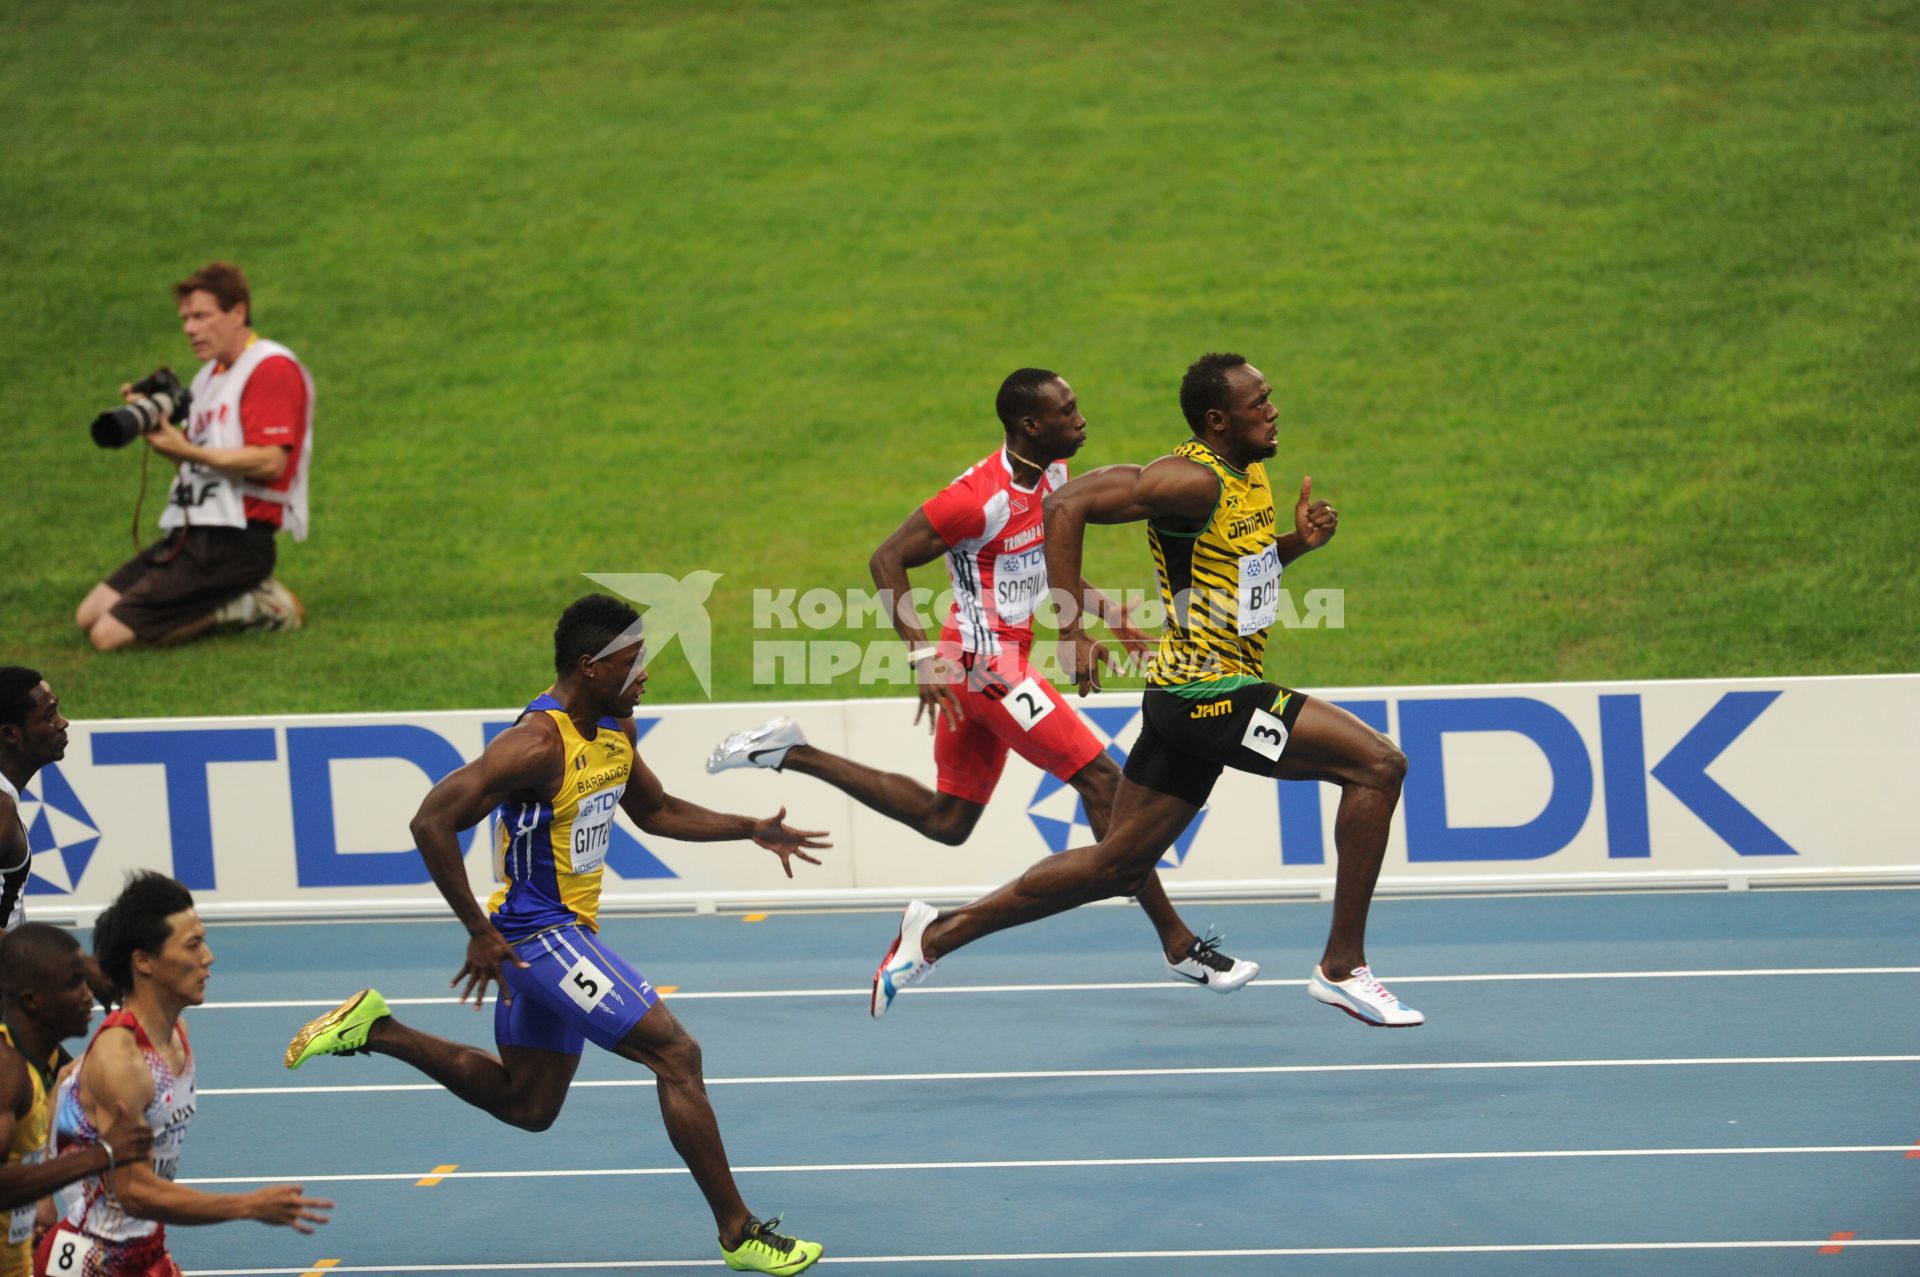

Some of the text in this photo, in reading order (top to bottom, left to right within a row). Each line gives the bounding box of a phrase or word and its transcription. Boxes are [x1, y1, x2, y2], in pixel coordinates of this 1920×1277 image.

[1228, 505, 1275, 540] JAMAIC
[1004, 527, 1035, 552] TRINIDAD
[1020, 546, 1045, 569] TD
[1015, 692, 1043, 720] 2
[1190, 700, 1232, 719] JAM
[1253, 725, 1282, 746] 3
[578, 763, 629, 794] BARBADOS
[573, 971, 598, 998] 5
[58, 1242, 76, 1271] 8
